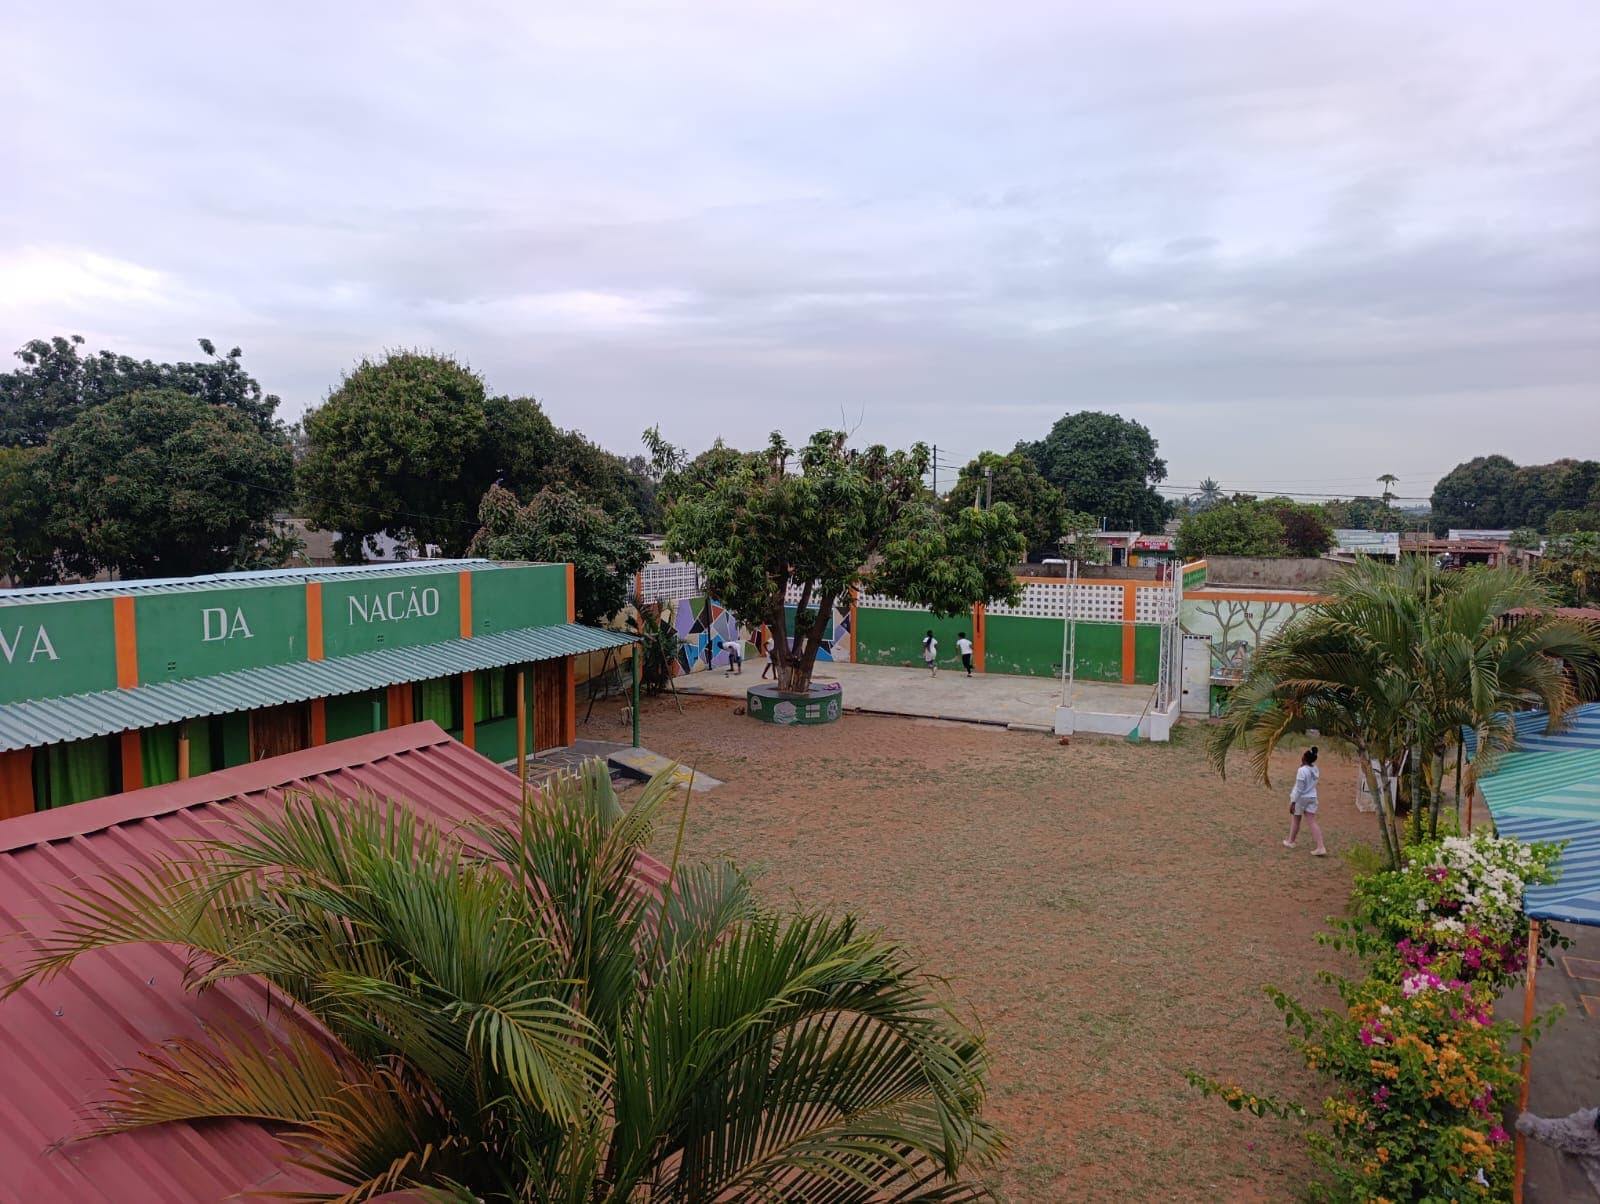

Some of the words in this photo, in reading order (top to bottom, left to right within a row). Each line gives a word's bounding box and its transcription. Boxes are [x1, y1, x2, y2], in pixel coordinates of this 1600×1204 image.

[0, 624, 61, 664] VA
[200, 606, 255, 642] DA
[347, 586, 440, 626] NAÇÃO
